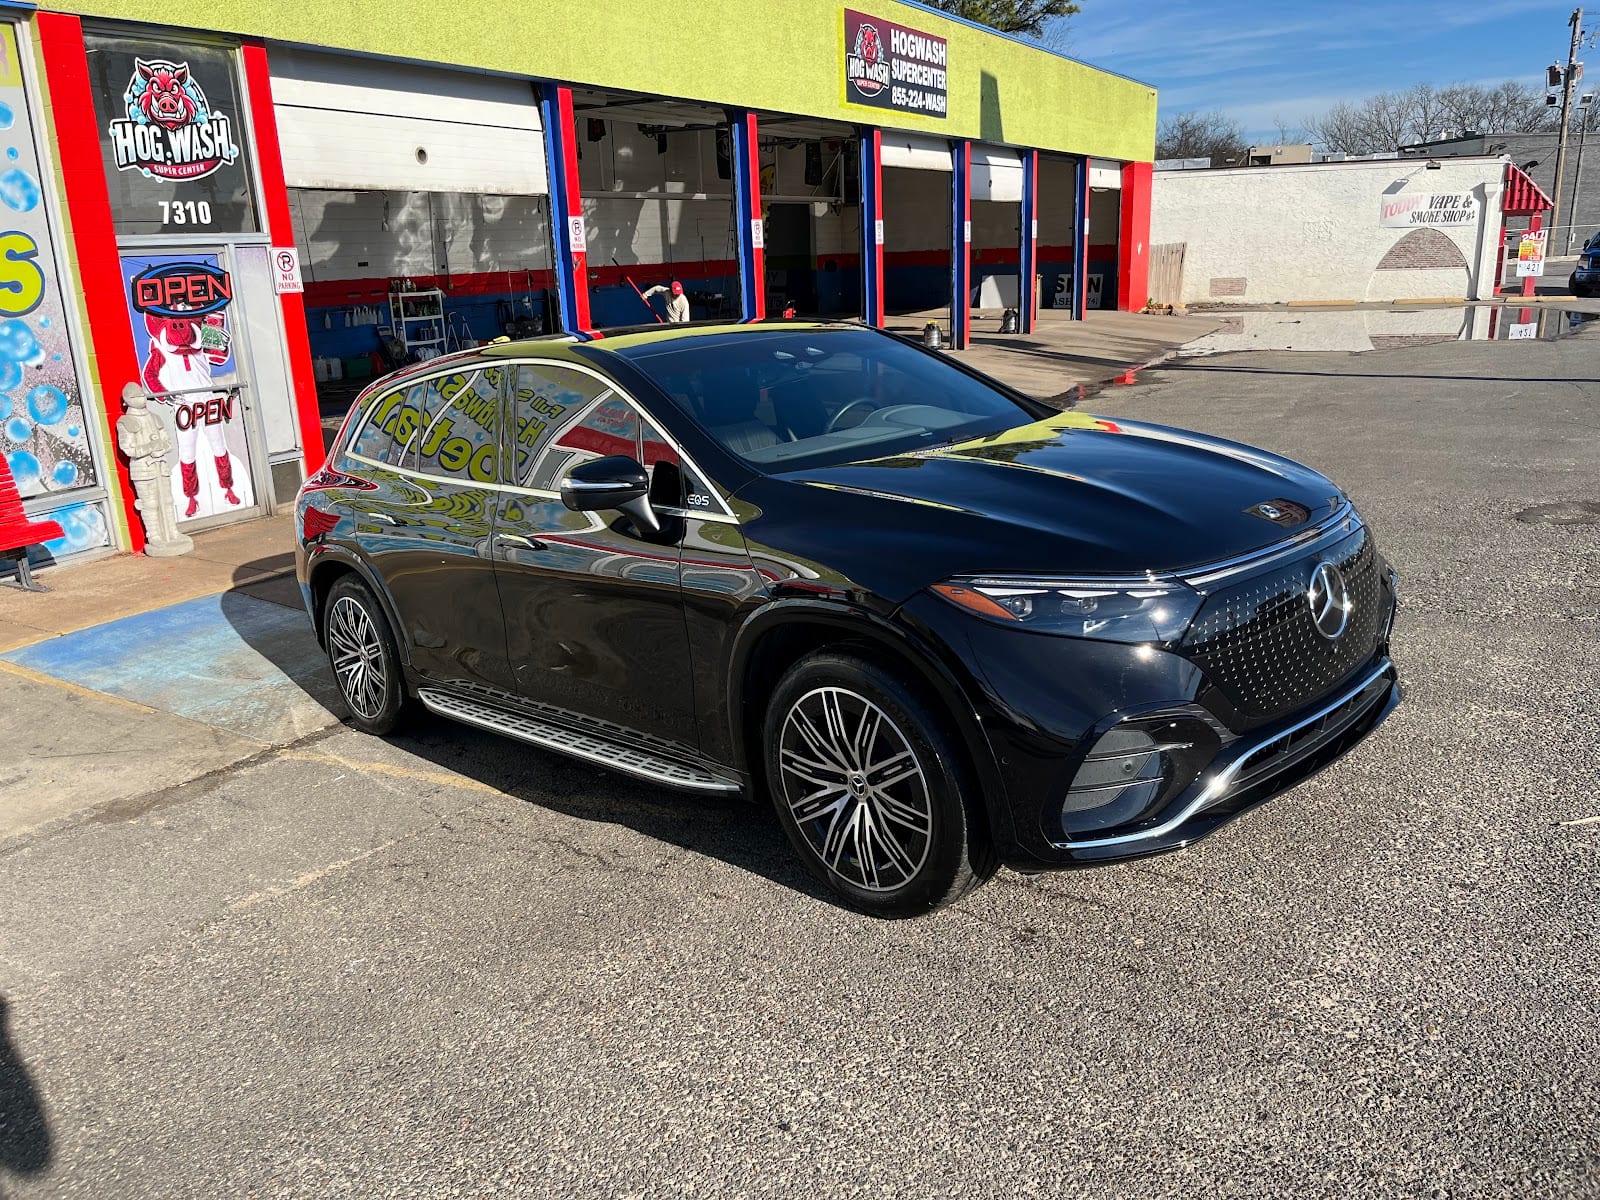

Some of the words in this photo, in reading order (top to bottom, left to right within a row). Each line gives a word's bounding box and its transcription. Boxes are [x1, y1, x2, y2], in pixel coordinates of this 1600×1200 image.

[890, 28, 946, 66] HOGWASH
[849, 57, 865, 78] HOG
[866, 61, 889, 88] WASH
[891, 58, 947, 90] SUPERCENTER
[891, 86, 946, 113] 855-224-WASH
[113, 121, 165, 166] HOG
[167, 119, 231, 164] WASH
[153, 164, 177, 176] SUPER
[178, 163, 206, 176] CENTER
[158, 200, 212, 224] 7310
[1429, 195, 1462, 210] VAPE
[1462, 195, 1473, 209] &
[1409, 210, 1441, 224] SMOKE
[1441, 210, 1466, 223] SHOP
[278, 281, 301, 290] PARKING
[282, 273, 294, 281] NO
[137, 272, 233, 308] OPEN
[175, 396, 235, 431] OPEN
[687, 494, 710, 506] EQS
